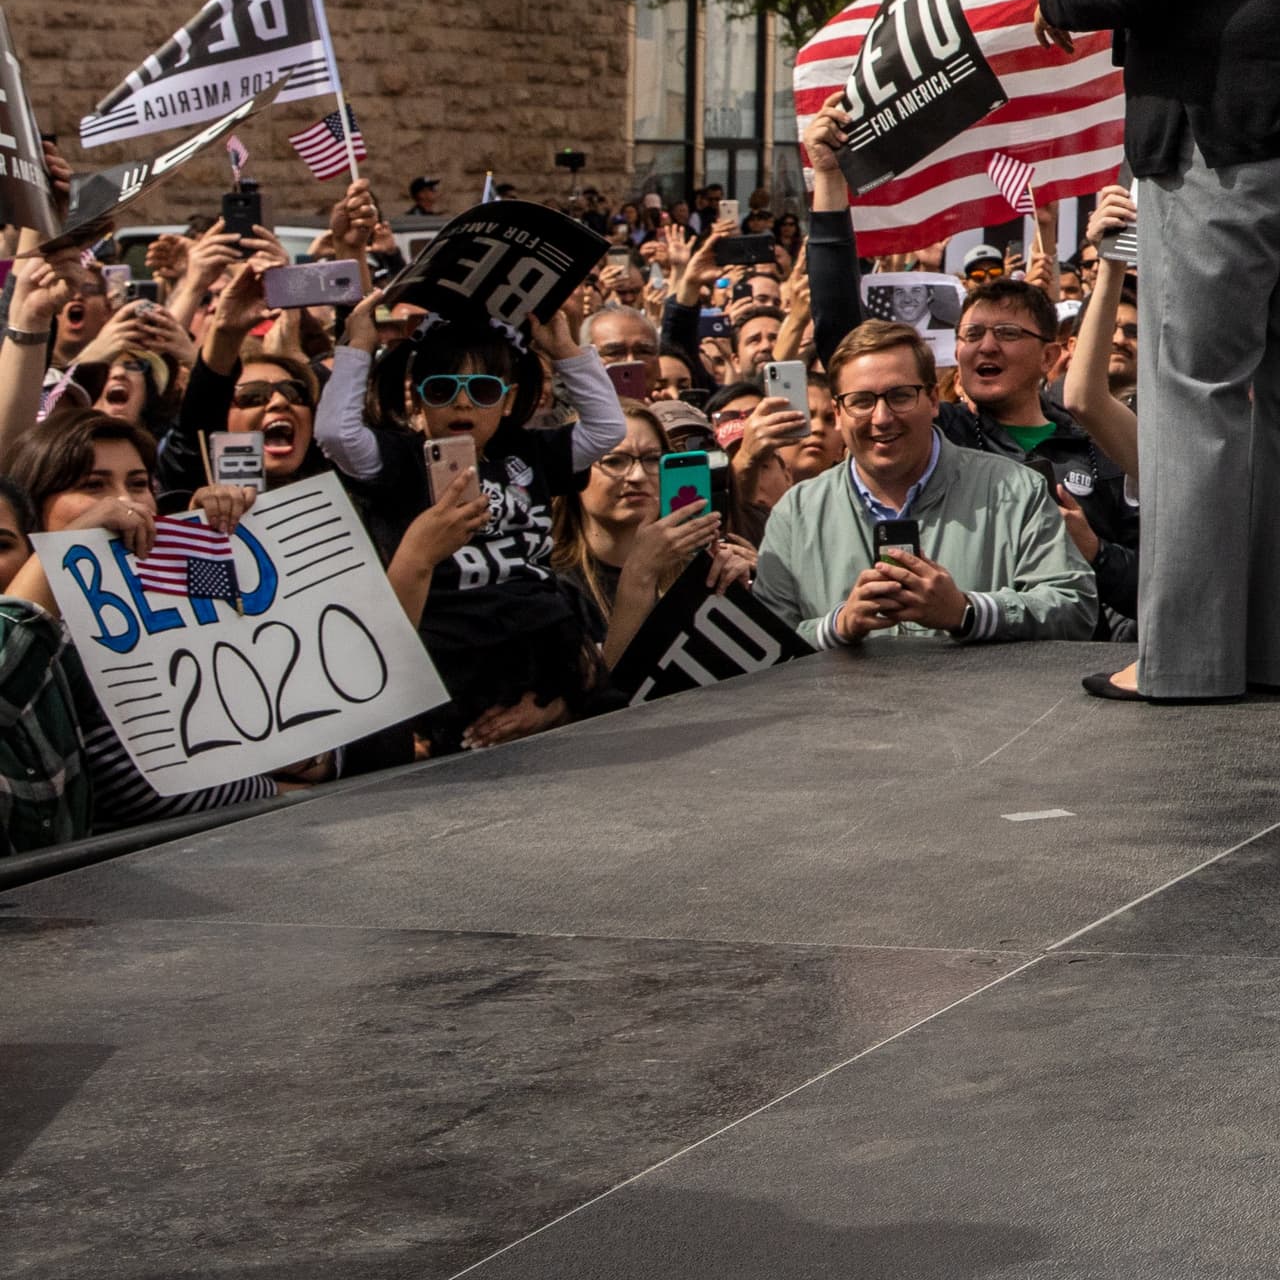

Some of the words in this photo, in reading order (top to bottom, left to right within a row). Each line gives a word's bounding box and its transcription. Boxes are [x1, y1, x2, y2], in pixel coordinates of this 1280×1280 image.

[870, 109, 899, 138] FOR
[895, 70, 952, 121] AMERICA
[1068, 470, 1092, 487] BETO
[168, 603, 388, 759] 2020
